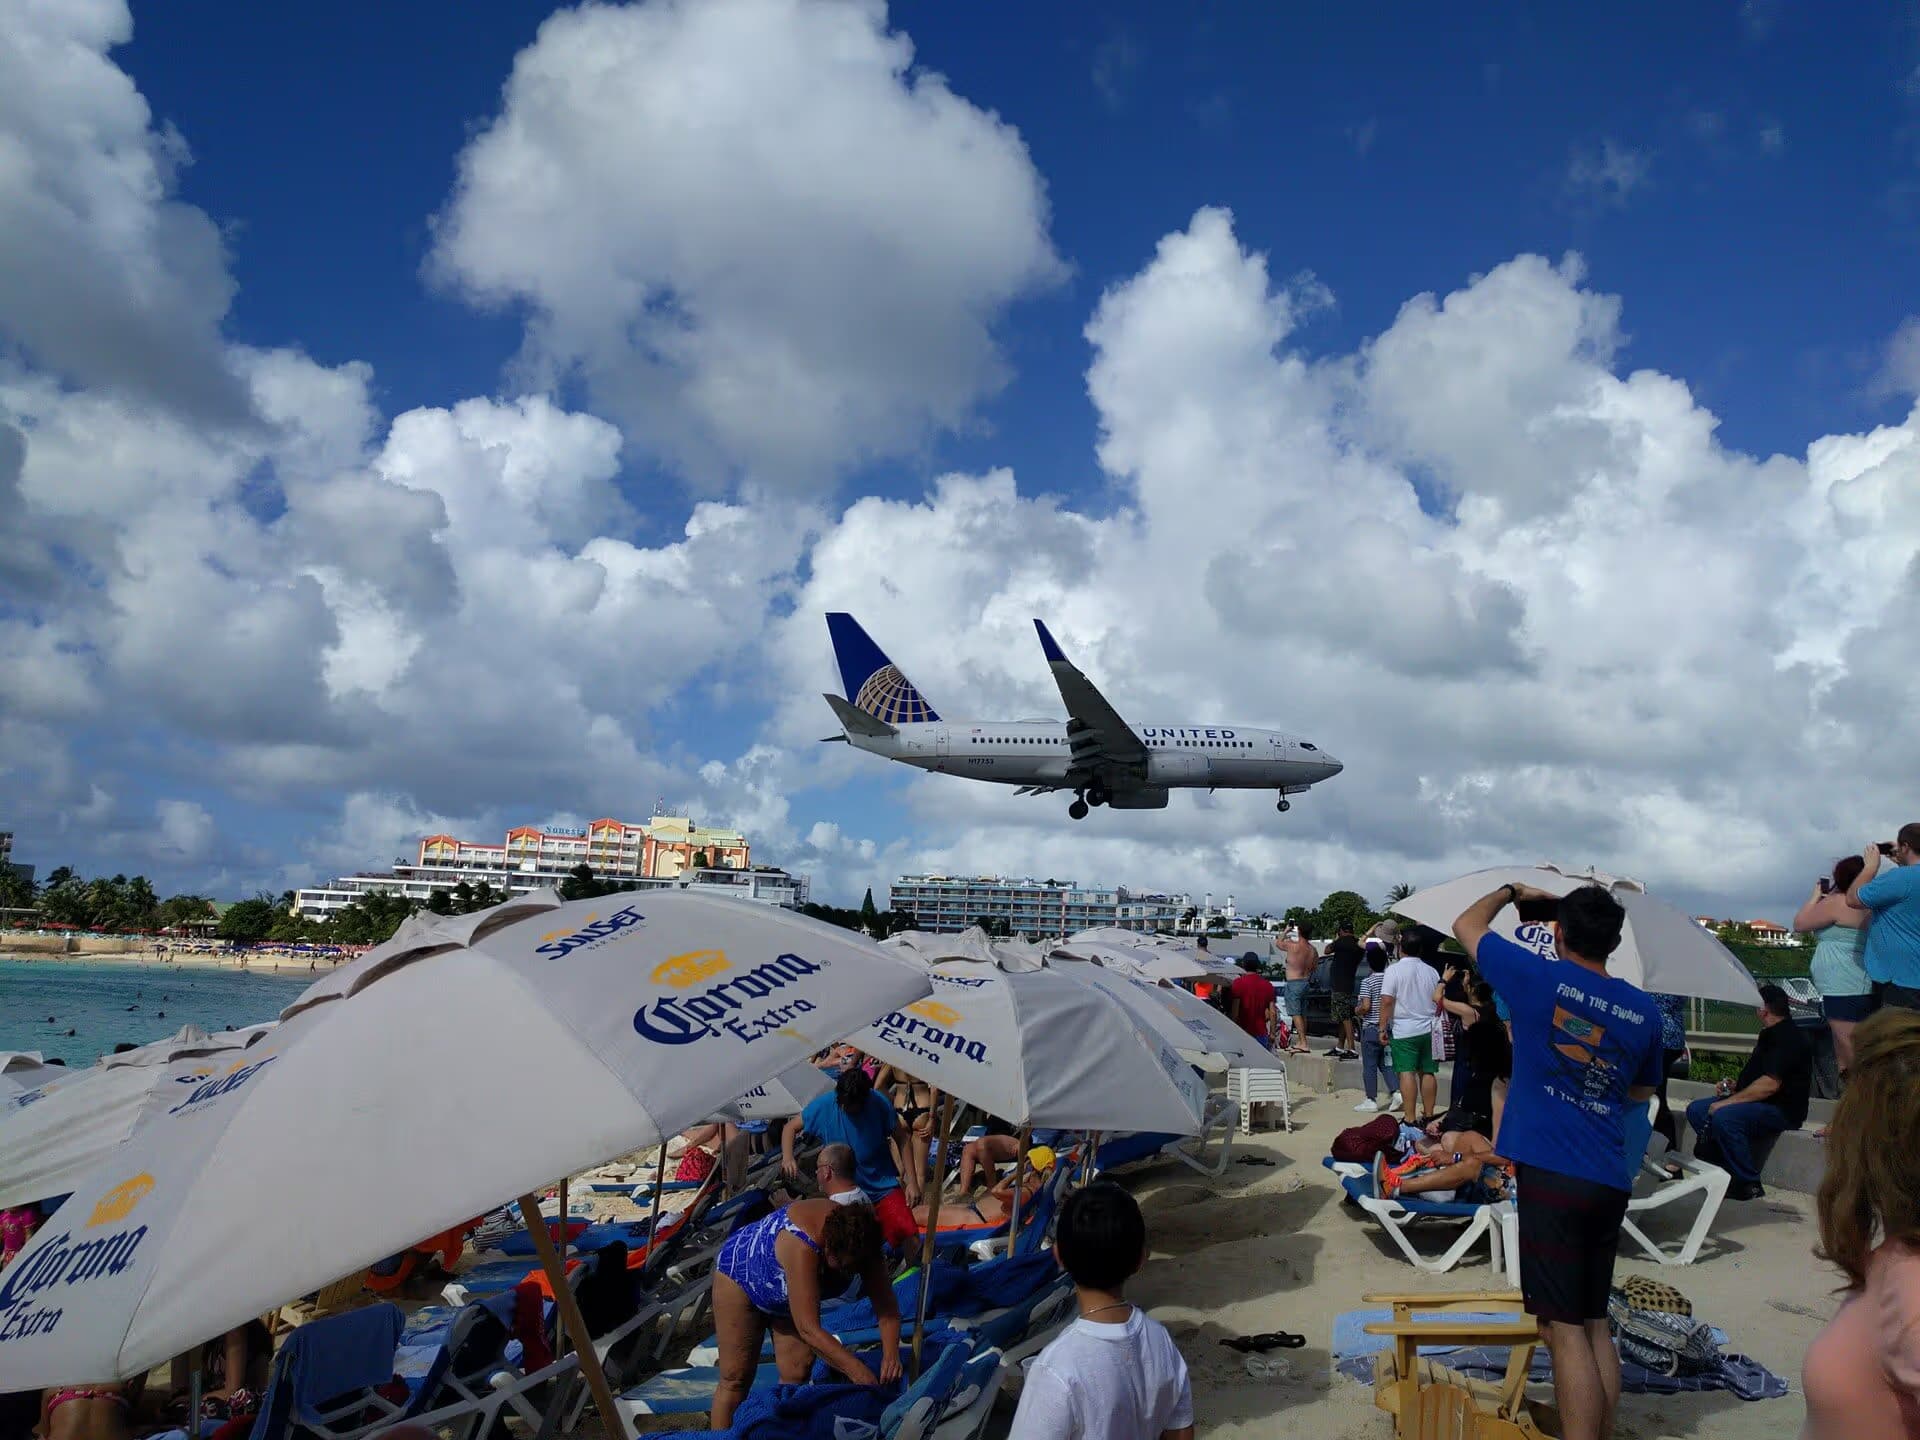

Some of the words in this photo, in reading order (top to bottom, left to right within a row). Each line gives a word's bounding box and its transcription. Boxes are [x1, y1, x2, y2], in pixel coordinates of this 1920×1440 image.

[1143, 728, 1235, 739] UNITED
[633, 953, 821, 1044] Corona
[1556, 982, 1585, 1003] FROM
[1589, 995, 1608, 1012] THE
[1611, 1004, 1645, 1025] SWAMP
[722, 998, 817, 1044] Extra
[872, 1011, 987, 1063] orona
[877, 1027, 940, 1065] Extra
[0, 1224, 149, 1318] Corona
[0, 1299, 64, 1342] Extra
